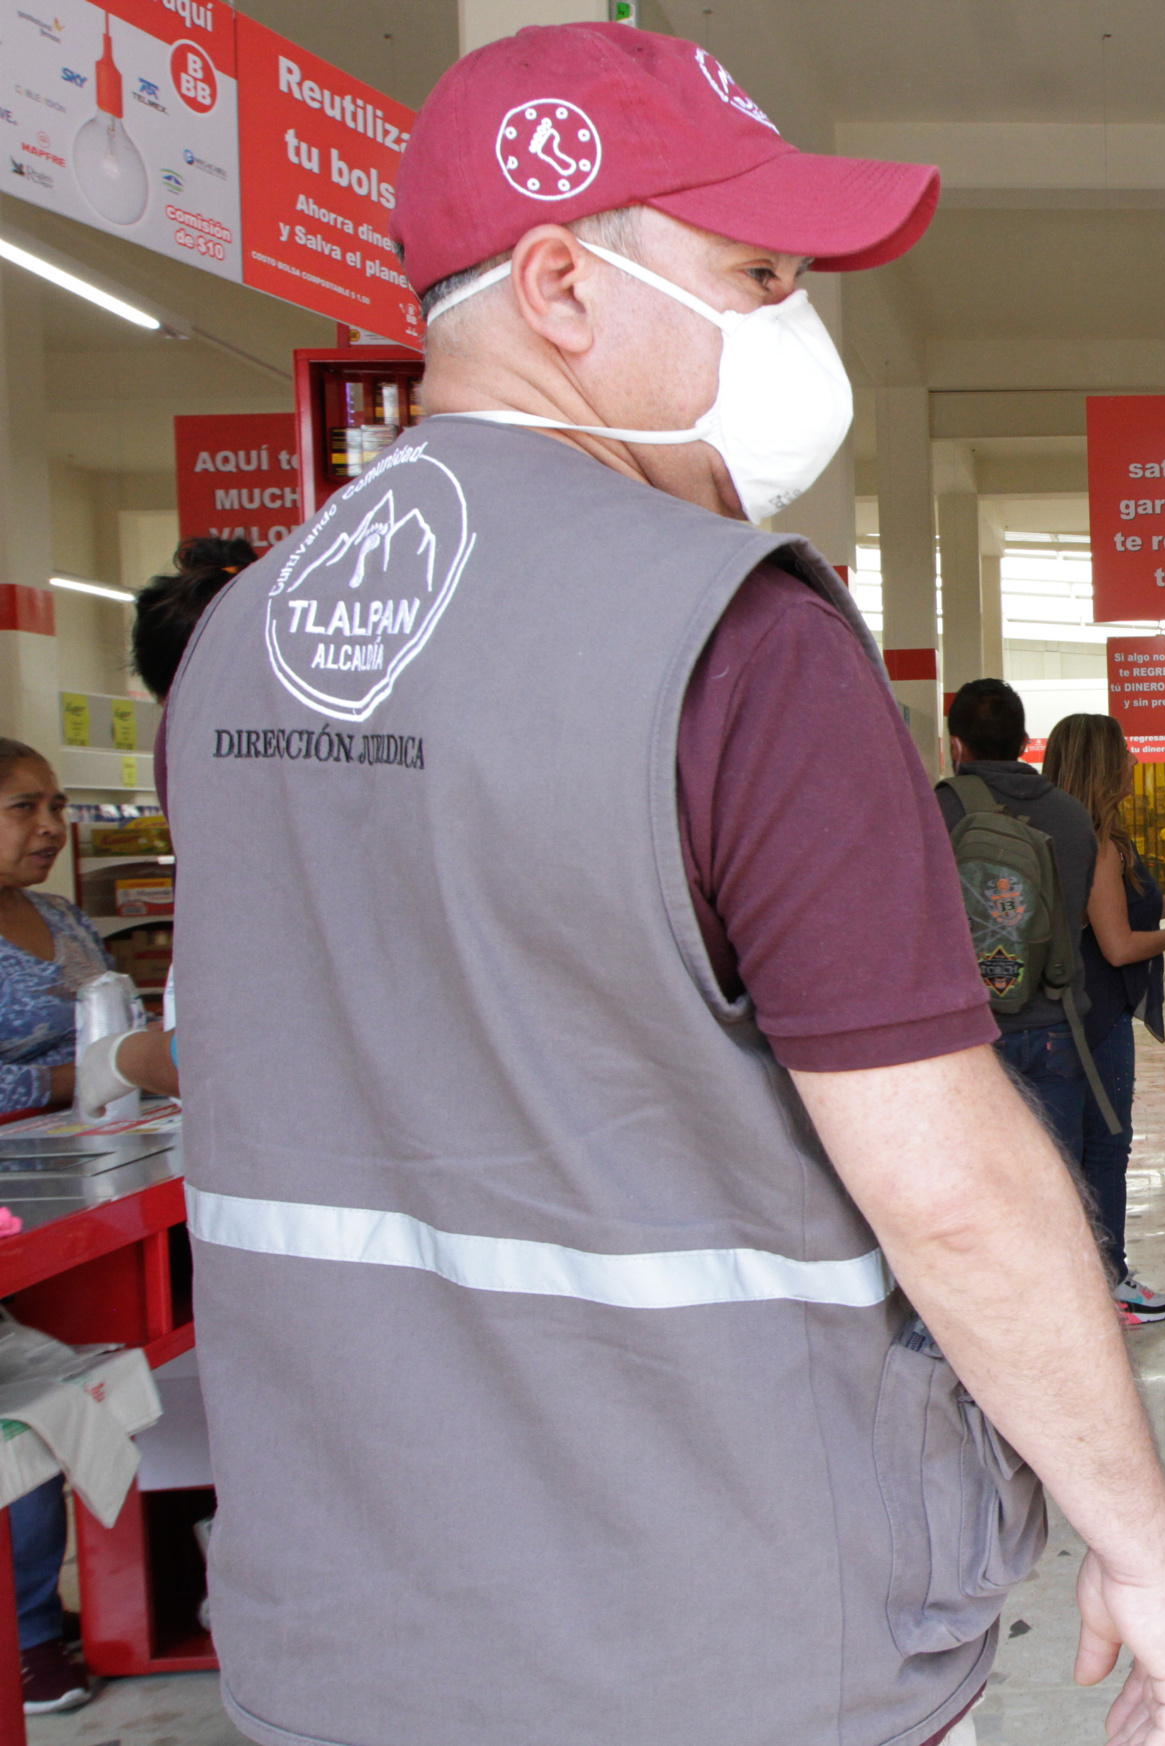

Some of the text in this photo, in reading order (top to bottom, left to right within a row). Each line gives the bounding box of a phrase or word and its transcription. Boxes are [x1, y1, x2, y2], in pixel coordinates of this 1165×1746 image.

[61, 67, 88, 88] SKY
[21, 141, 66, 168] MAPFRE
[285, 129, 396, 209] tu bols
[165, 204, 232, 243] Comisión
[296, 194, 394, 252] Ahorra dine
[175, 228, 224, 261] de $10
[279, 222, 409, 288] y Salva el plane
[251, 251, 276, 267] COSTO
[277, 261, 301, 276] BOLSA
[302, 272, 351, 297] COMPOSTABLE
[194, 446, 269, 473] AQUÍ
[214, 486, 299, 510] MUCH
[1114, 532, 1143, 551] te
[288, 597, 420, 636] TLALPAN
[311, 635, 384, 671] ALCALDÍA
[1114, 653, 1124, 662] Si
[1127, 653, 1149, 664] algo
[1119, 668, 1130, 677] te
[1124, 682, 1165, 692] DINERO
[1124, 700, 1130, 709] y
[1133, 698, 1149, 707] sin
[212, 723, 355, 763] DIRECCIÓN
[1000, 901, 1015, 911] 13
